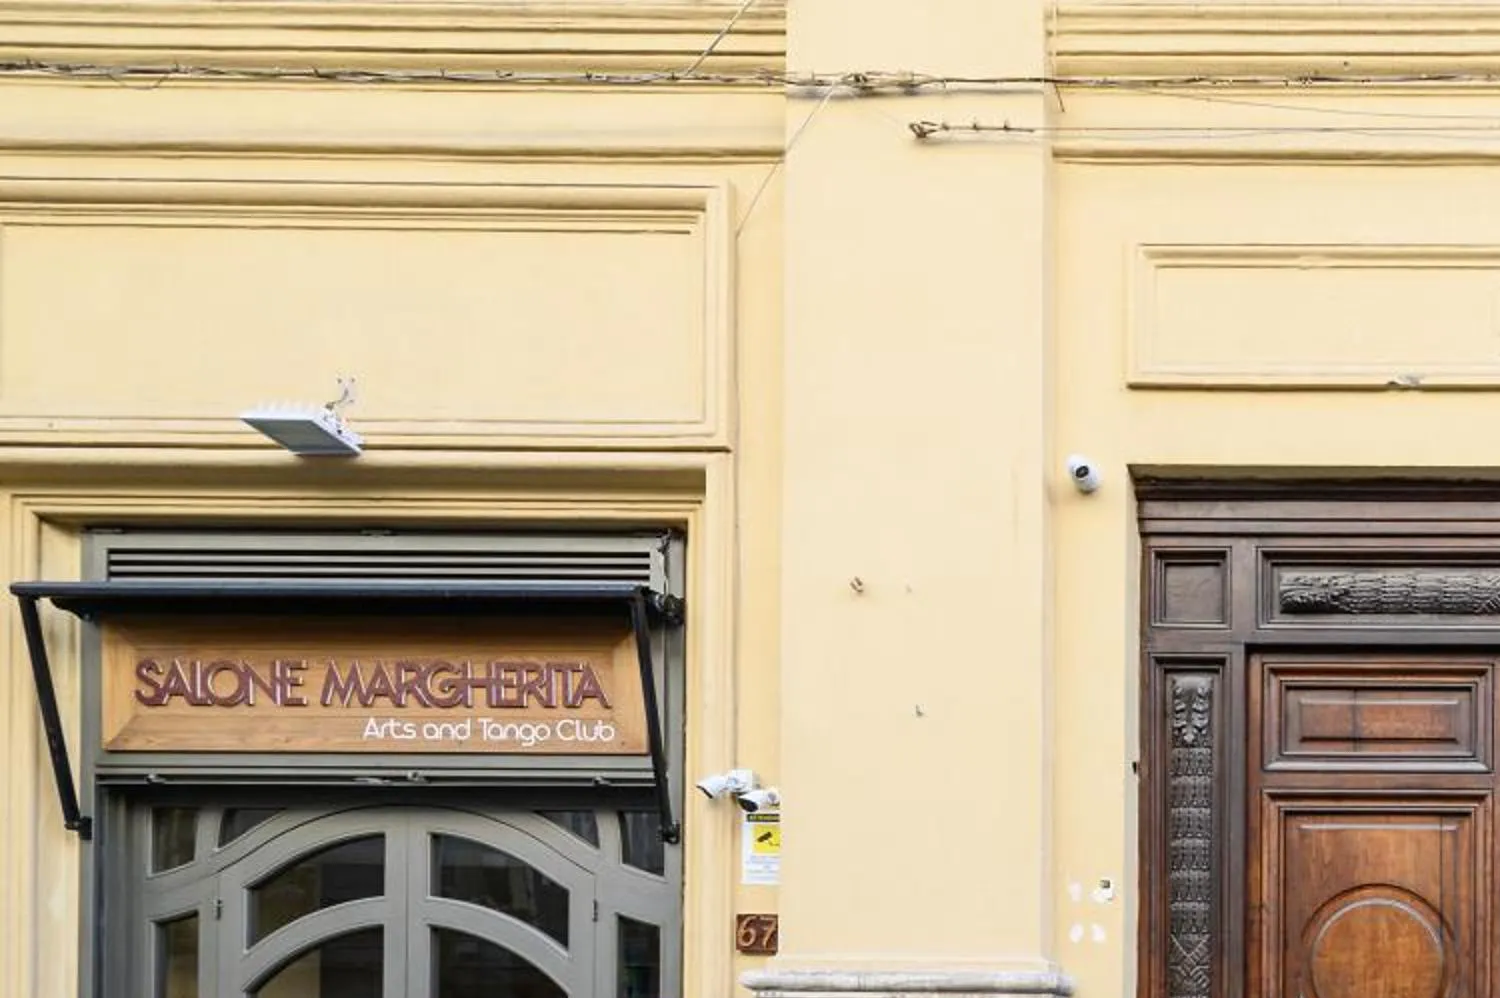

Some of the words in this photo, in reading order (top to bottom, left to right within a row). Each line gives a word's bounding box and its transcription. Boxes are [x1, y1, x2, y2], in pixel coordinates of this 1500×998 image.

[135, 658, 309, 707] SALONE
[320, 659, 613, 709] MARGHERITA
[363, 717, 417, 740] Arts
[423, 718, 471, 740] and
[478, 718, 551, 747] Tango
[556, 718, 616, 743] Club
[739, 915, 777, 949] 67
